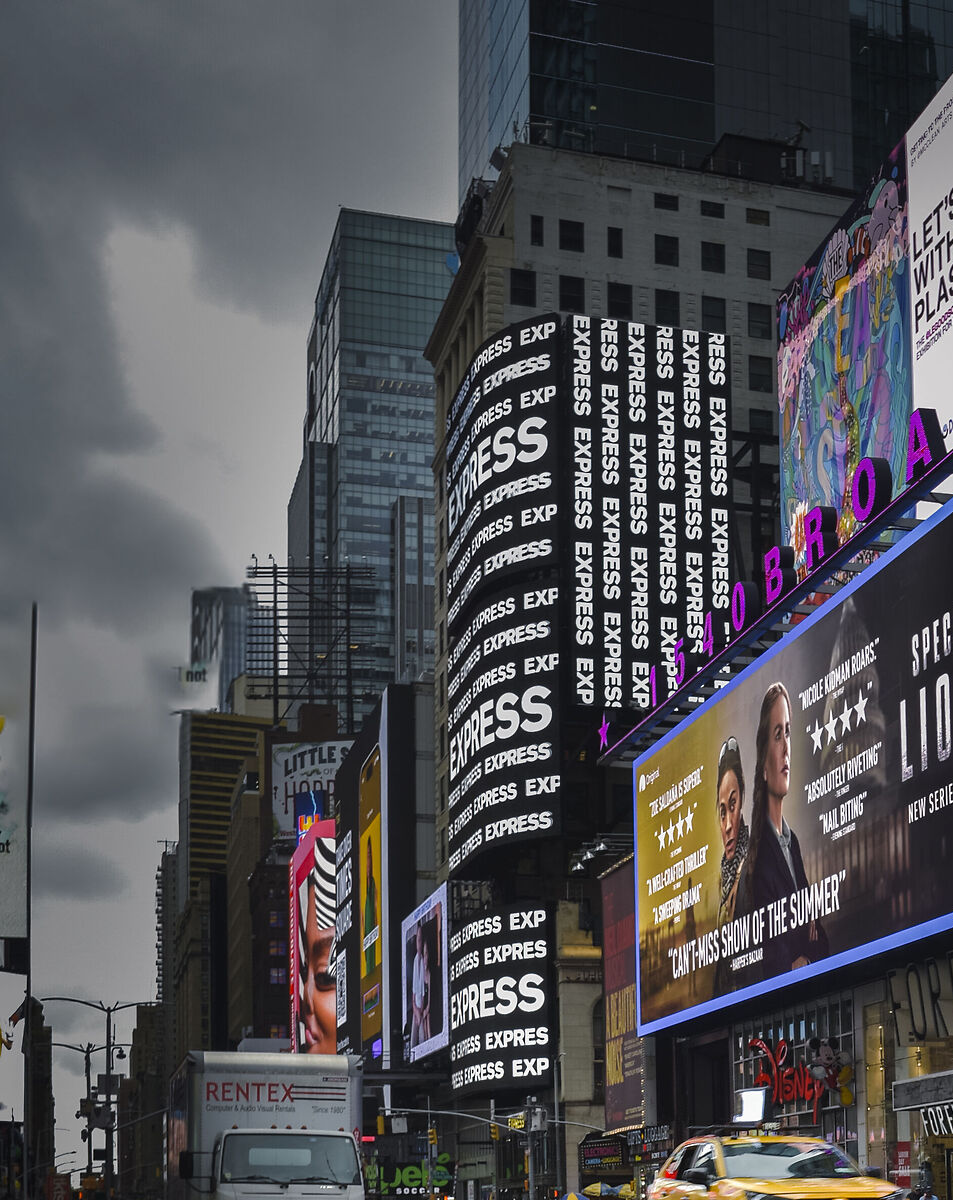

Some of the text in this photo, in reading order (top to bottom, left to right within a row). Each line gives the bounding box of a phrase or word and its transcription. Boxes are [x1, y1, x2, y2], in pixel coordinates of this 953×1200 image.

[471, 336, 512, 382] EXPRESS
[916, 335, 924, 350] THE
[628, 322, 645, 422] EXPRESS
[682, 329, 700, 429] EXPRESS
[601, 384, 619, 486] EXPRESS
[657, 390, 675, 491] EXPRESS
[709, 398, 727, 497] EXPRESS
[448, 417, 548, 536] EXPRESS
[573, 315, 593, 645] EXPRESS EXPRESS
[483, 621, 550, 656] EXPRESS
[824, 659, 850, 694] KIDMAN
[450, 685, 552, 782] EXPRESS
[284, 746, 336, 778] LITTLE
[474, 775, 560, 815] EXPRESS EXP
[908, 796, 926, 824] NEW
[485, 811, 553, 842] EXPRESS
[462, 909, 546, 943] EXPRESS EXP
[721, 914, 750, 958] SHOW
[752, 907, 765, 946] OF
[767, 897, 788, 939] THE
[484, 940, 547, 965] EXPRES
[451, 973, 545, 1031] EXPRESS
[206, 1082, 294, 1102] RENTEX
[464, 1057, 549, 1085] EXPRESS EXP
